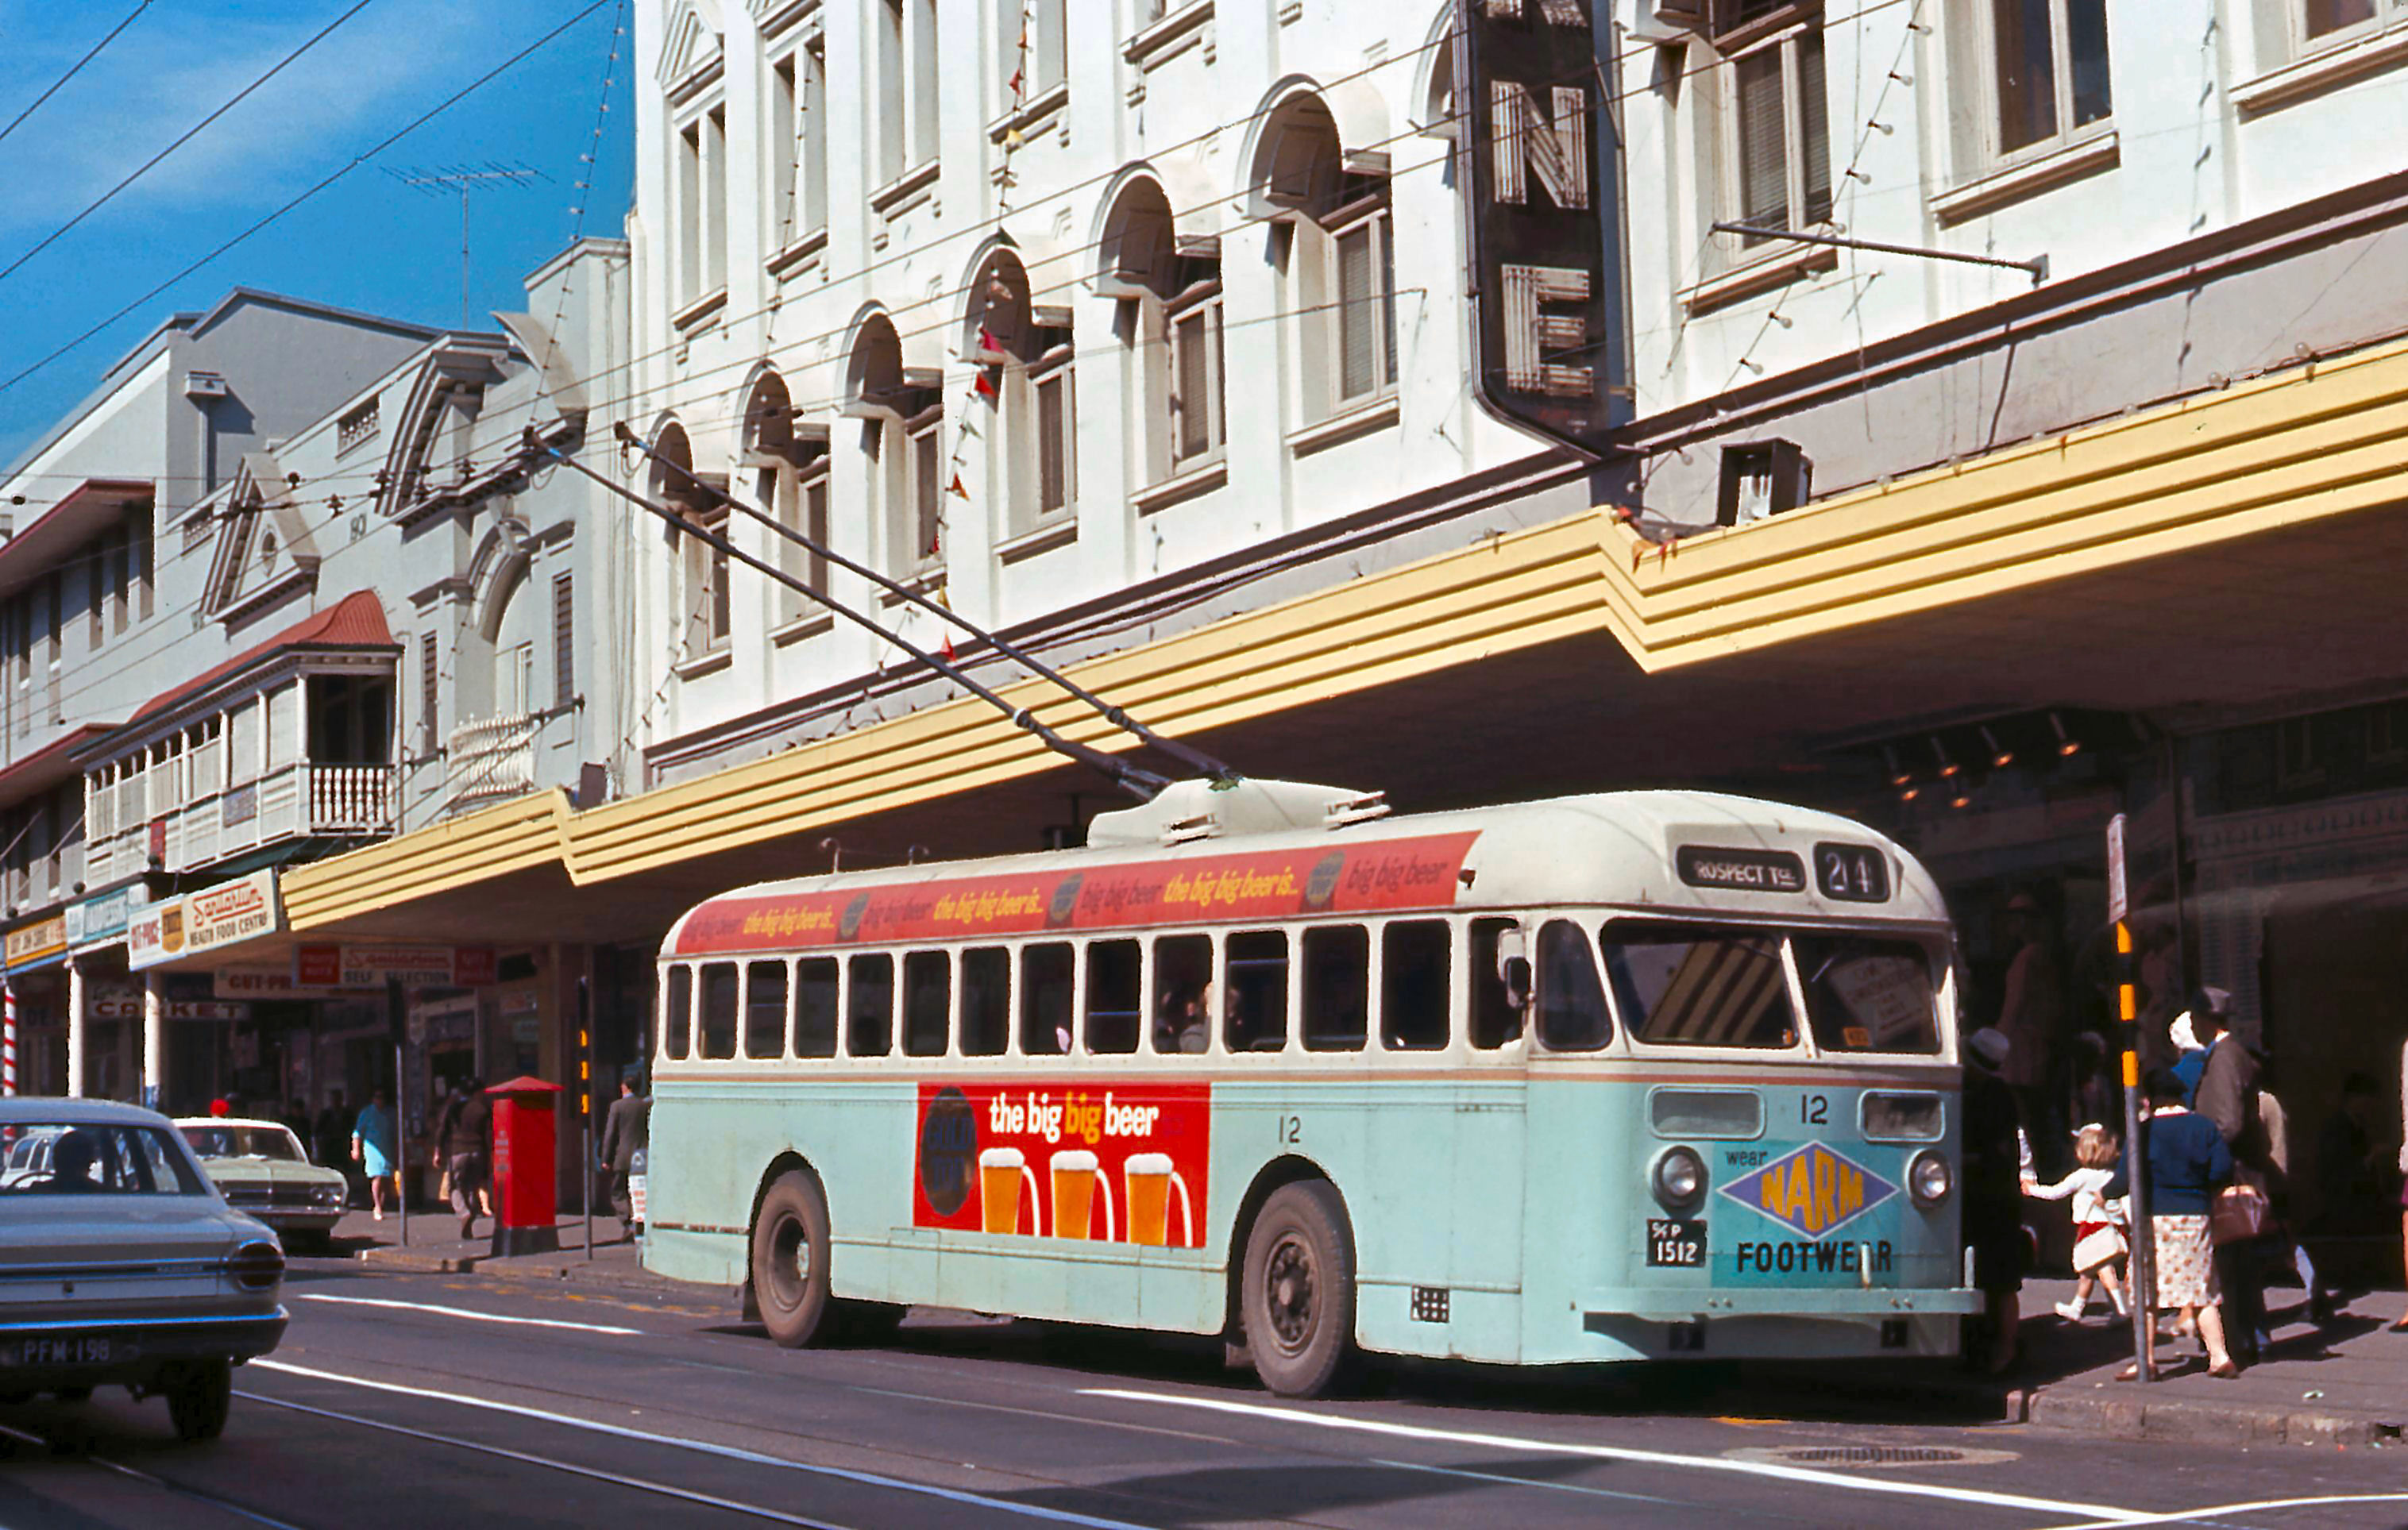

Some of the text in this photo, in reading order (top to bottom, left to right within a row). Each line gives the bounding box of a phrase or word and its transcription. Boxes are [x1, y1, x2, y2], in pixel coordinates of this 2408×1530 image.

[1487, 0, 1593, 395] NE
[1163, 874, 1190, 902] the
[1189, 873, 1218, 907] big
[1214, 870, 1243, 904] big
[1241, 868, 1278, 898] beer
[1347, 859, 1375, 895] big
[1375, 857, 1404, 892] big
[1404, 854, 1448, 885] beer
[933, 894, 955, 920] the
[955, 892, 977, 924] big
[976, 891, 998, 921] big
[997, 889, 1025, 916] beer
[216, 921, 236, 940] FOOD
[990, 1091, 1160, 1144] the big big beer
[1801, 1095, 1827, 1124] 12
[1279, 1116, 1301, 1143] 12
[1726, 1150, 1768, 1166] wear
[1762, 1148, 1864, 1232] NARM
[1657, 1240, 1698, 1262] 1512
